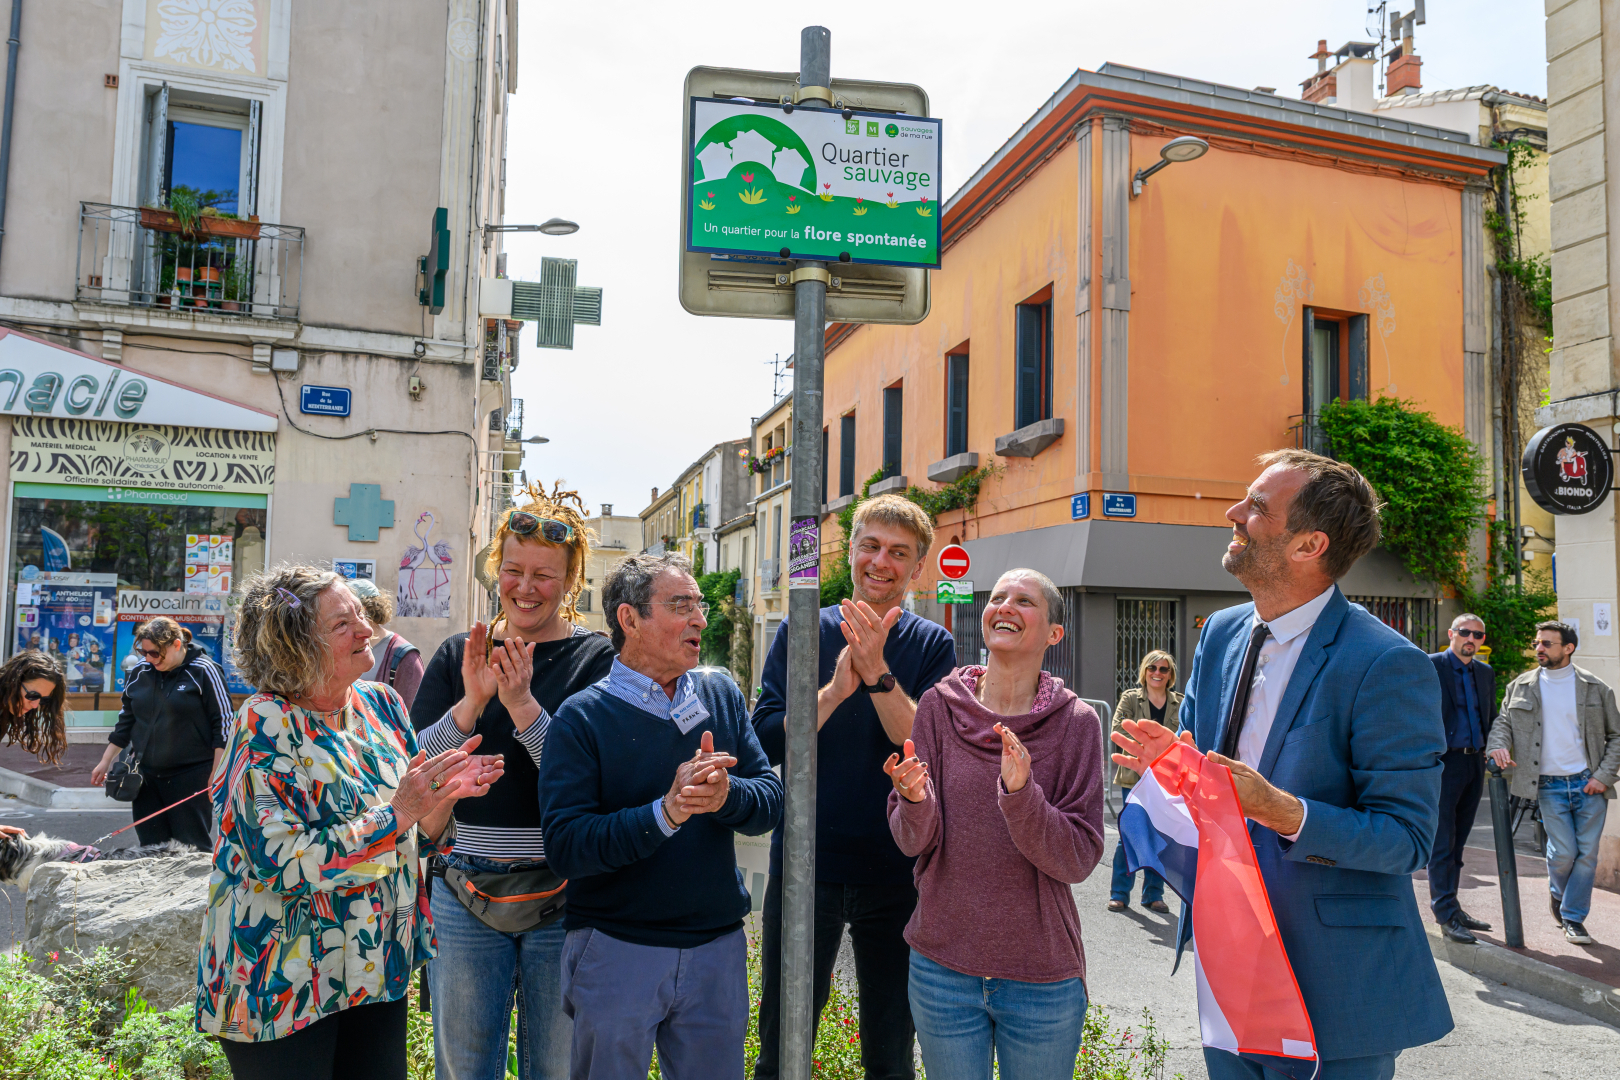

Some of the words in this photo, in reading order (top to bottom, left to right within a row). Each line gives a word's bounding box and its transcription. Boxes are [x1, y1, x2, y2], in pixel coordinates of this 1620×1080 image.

[822, 142, 909, 168] Quartier
[843, 166, 930, 190] sauvage
[704, 222, 718, 233] Un
[722, 225, 761, 238] quartier
[764, 229, 789, 241] pour
[791, 228, 800, 239] la
[804, 226, 842, 244] flore
[846, 229, 927, 248] spontanée
[30, 441, 63, 449] MATÉRIEL
[65, 443, 96, 451] MÉDICAL
[1586, 432, 1608, 460] MONTPELLIER
[126, 456, 168, 464] PHARMASUD
[124, 489, 188, 501] Pharmasud
[1558, 486, 1593, 497] BIONDO
[121, 594, 200, 612] Myocalm
